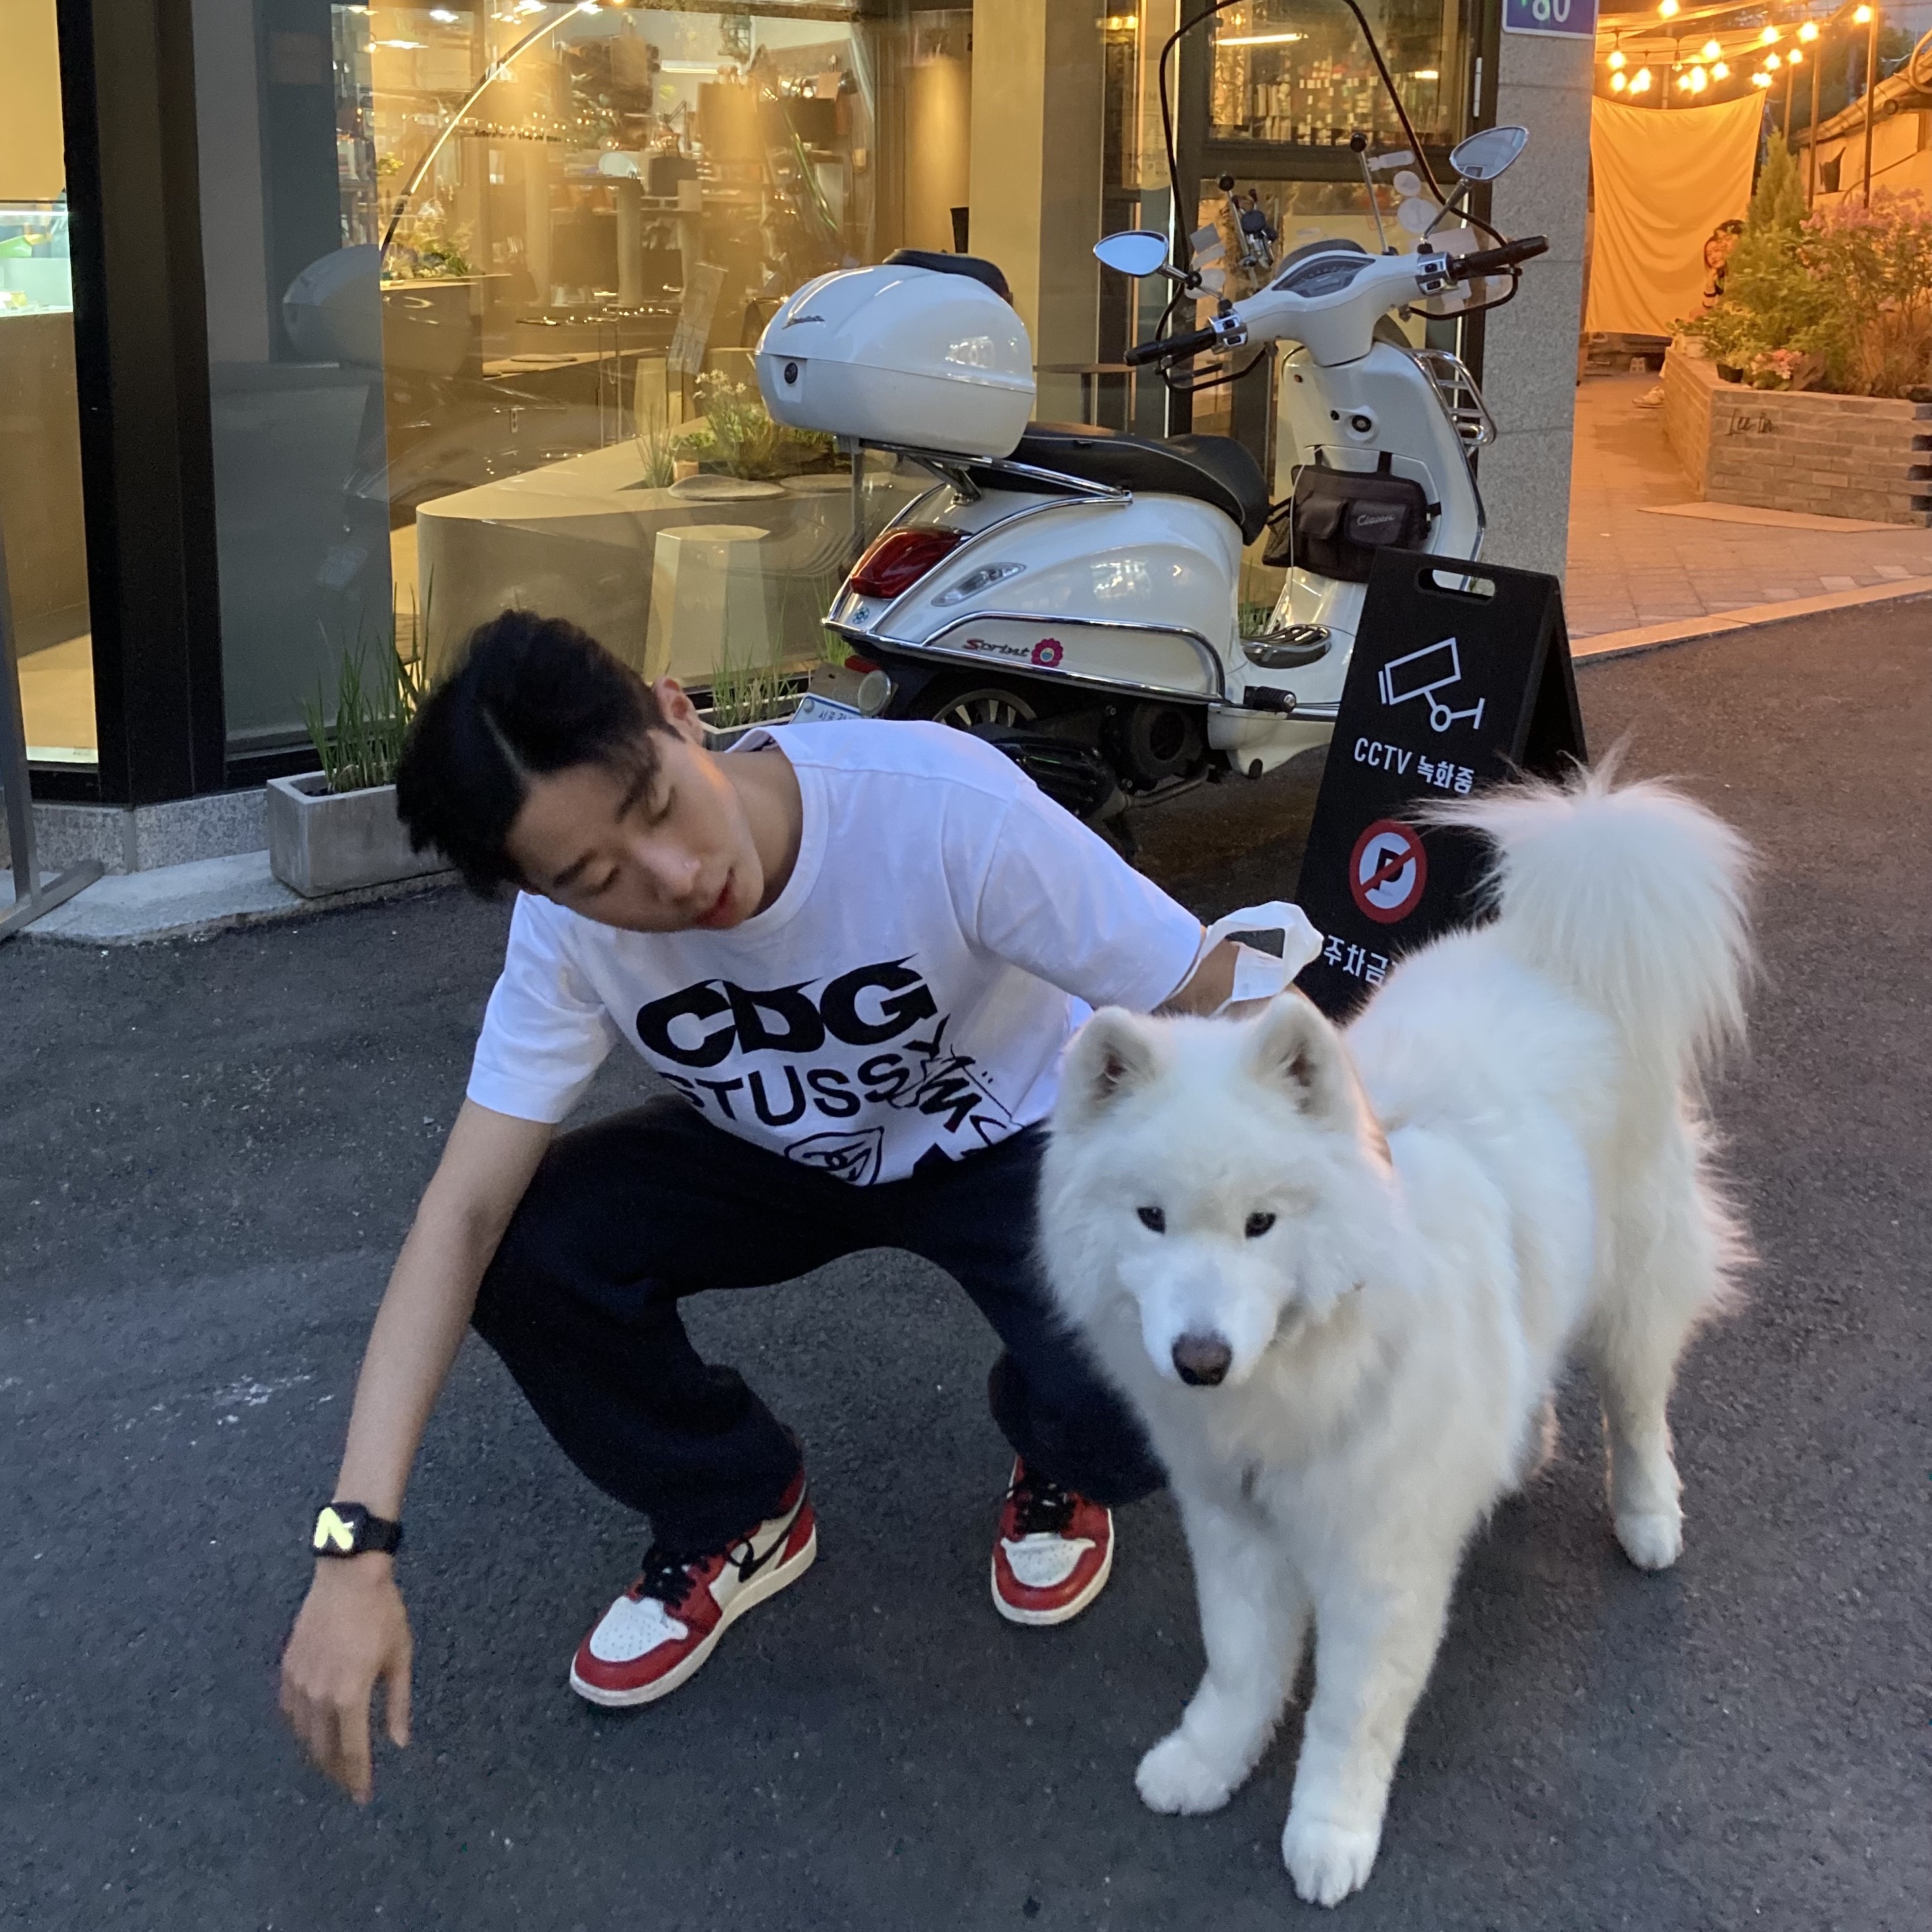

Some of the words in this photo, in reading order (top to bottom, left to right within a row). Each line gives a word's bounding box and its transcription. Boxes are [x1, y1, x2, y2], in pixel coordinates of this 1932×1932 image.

[961, 638, 1030, 657] Sprint
[1354, 737, 1412, 775] CCTV
[1417, 755, 1475, 794] 녹화중
[1323, 934, 1390, 987] 주차금
[636, 953, 938, 1067] CDG
